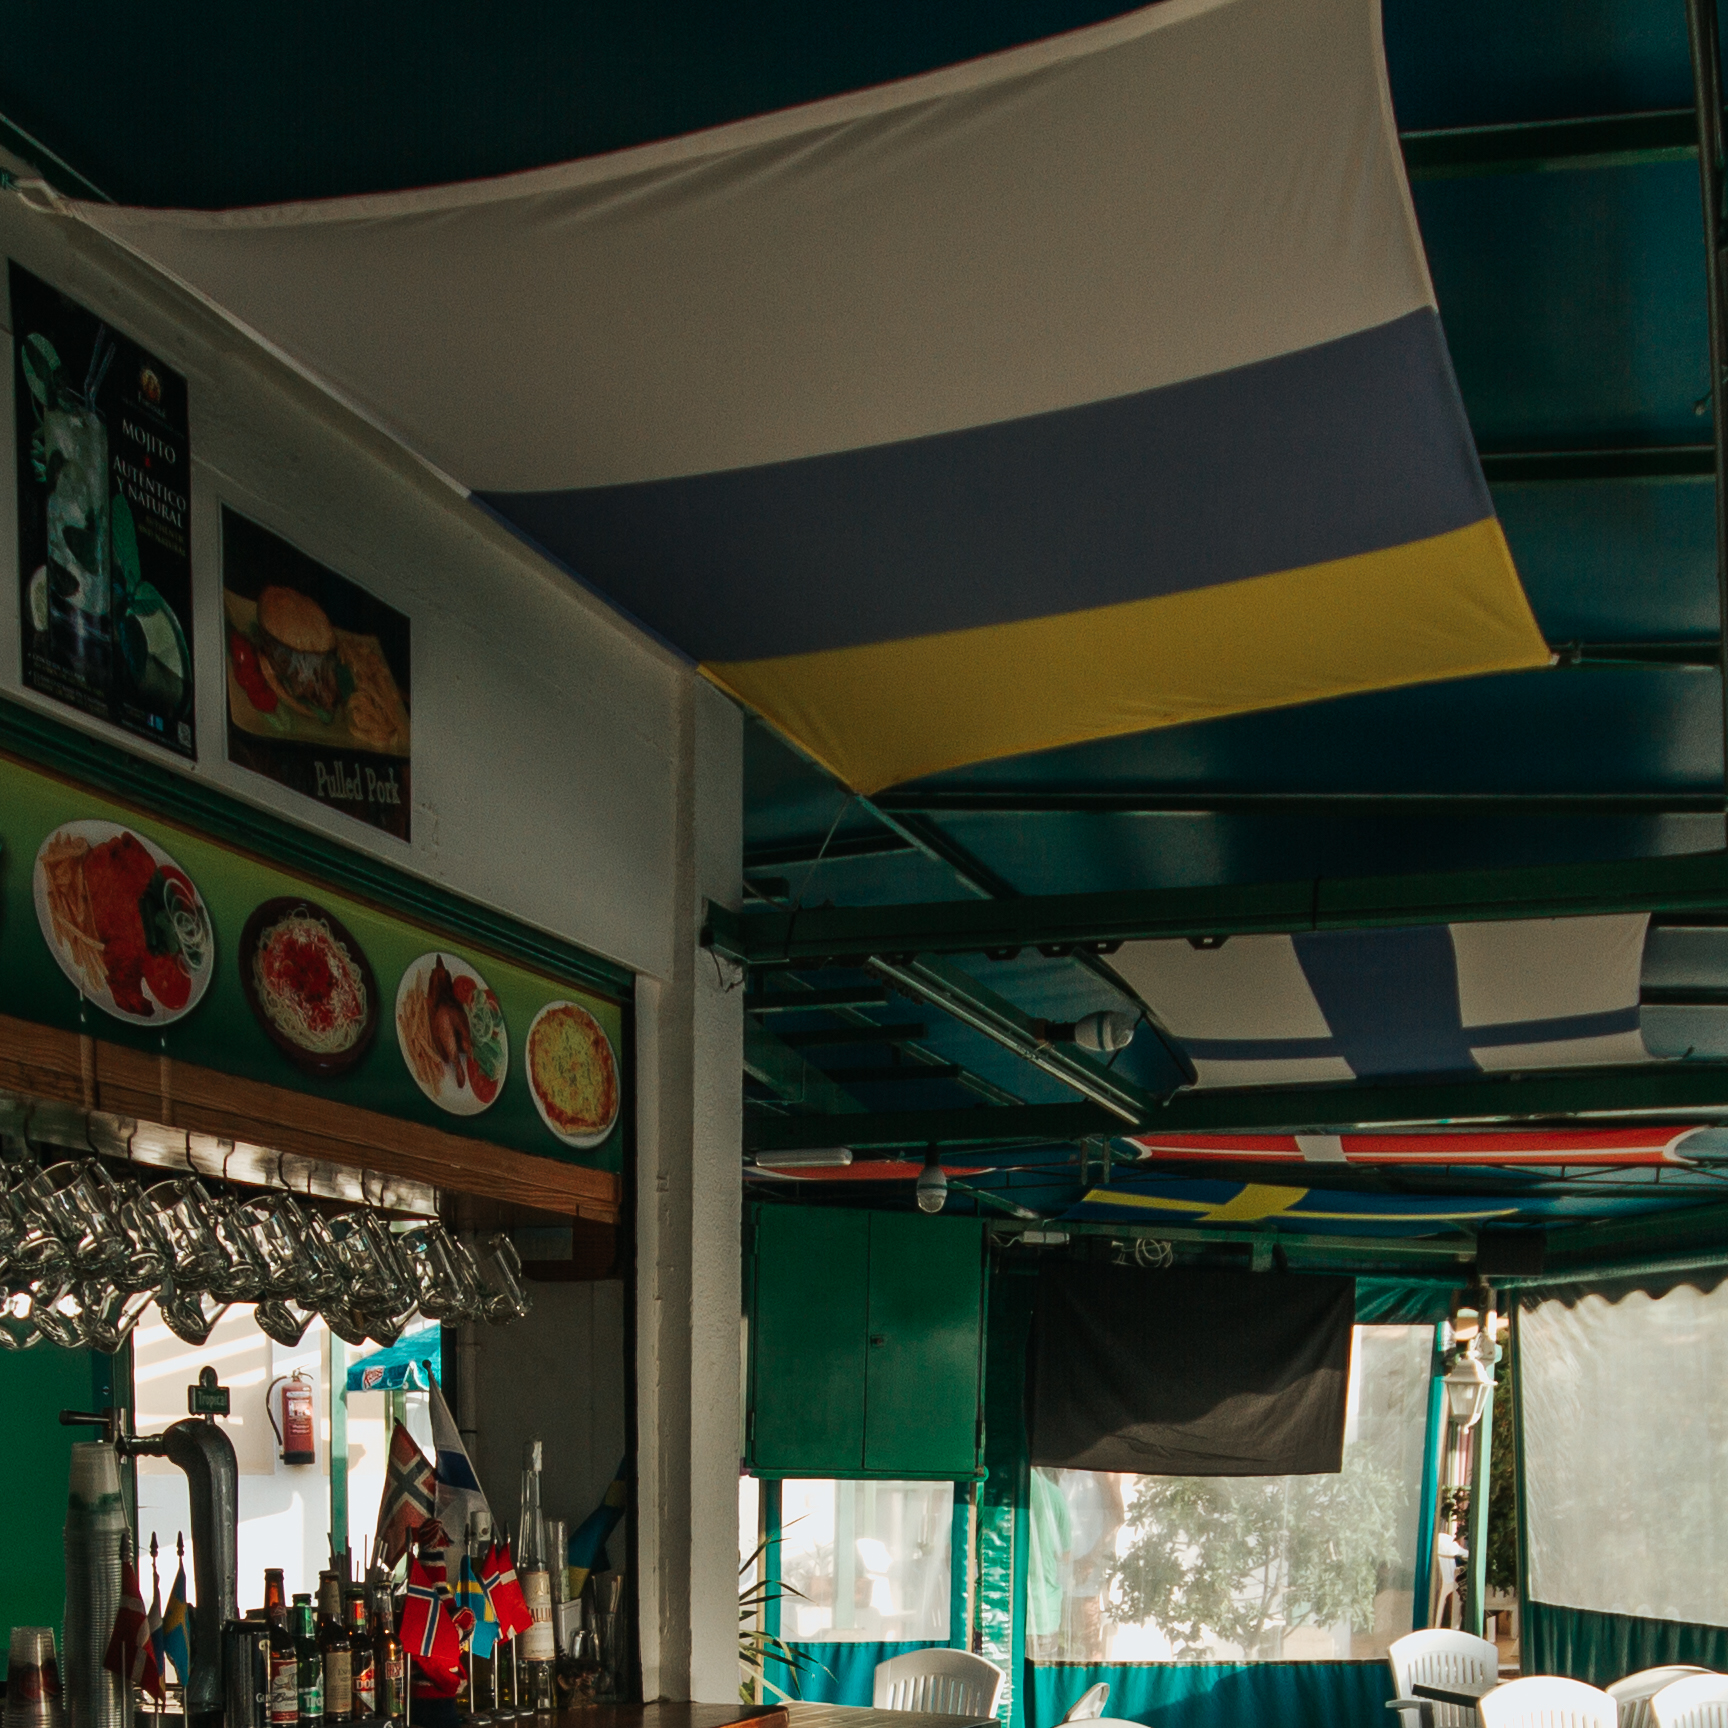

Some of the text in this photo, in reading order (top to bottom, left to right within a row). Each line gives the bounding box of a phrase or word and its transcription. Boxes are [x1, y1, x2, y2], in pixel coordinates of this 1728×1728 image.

[121, 418, 177, 465] MOJITO
[116, 474, 184, 529] Y NATURAL
[313, 759, 402, 805] Pulled Pork
